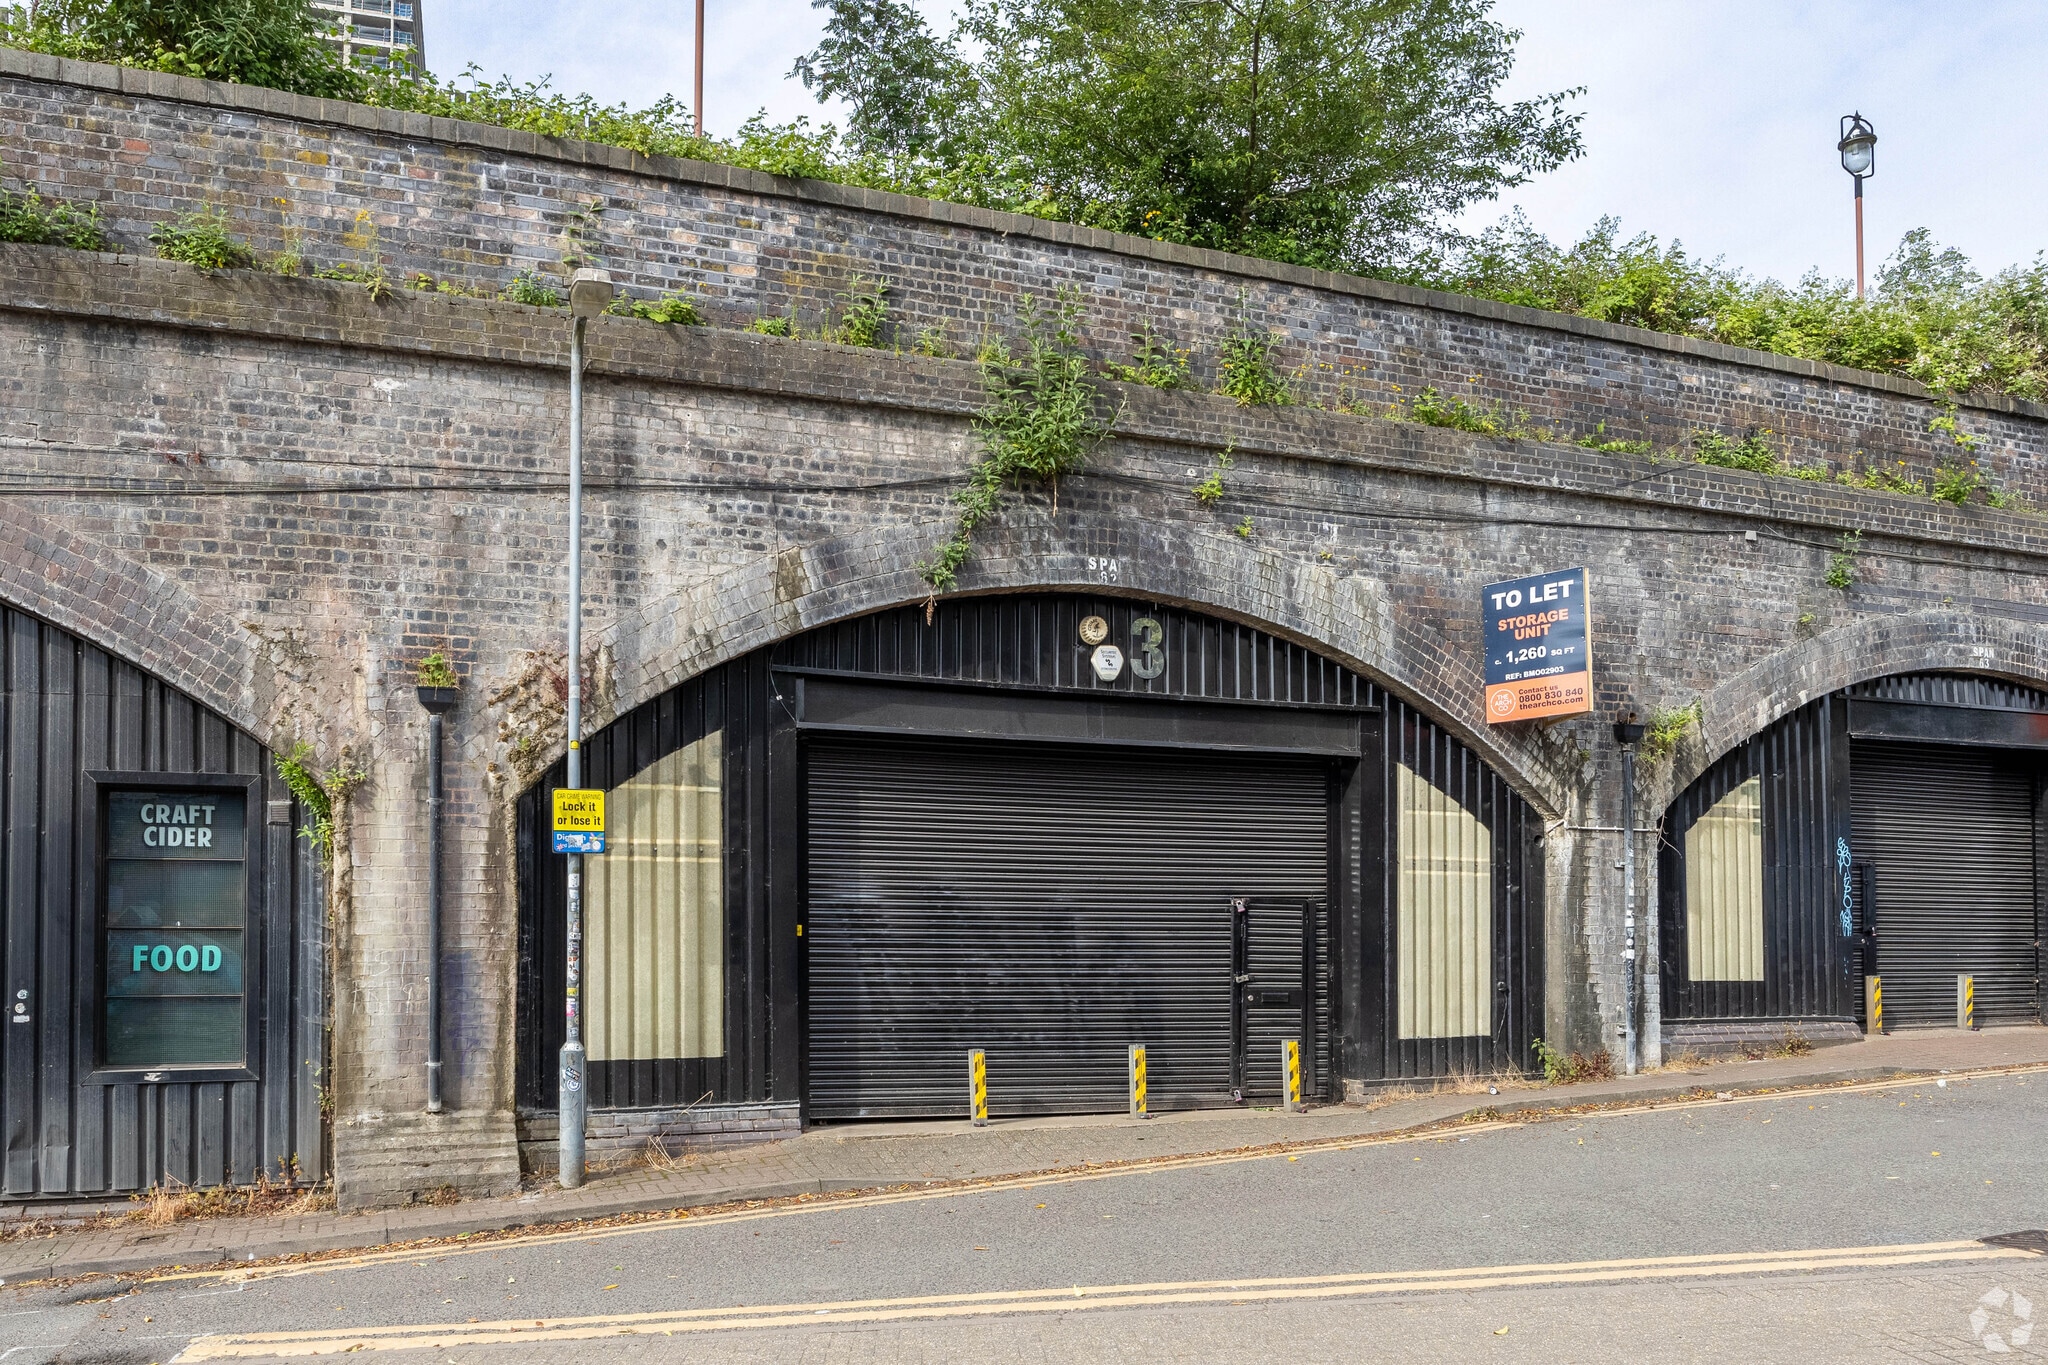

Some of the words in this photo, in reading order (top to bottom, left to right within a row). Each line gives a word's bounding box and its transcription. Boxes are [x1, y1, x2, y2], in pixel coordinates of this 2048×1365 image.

[1491, 590, 1522, 610] TO
[1530, 580, 1574, 604] LET
[1498, 608, 1569, 631] STORAGE
[1514, 624, 1551, 640] UNIT
[1130, 618, 1165, 680] 3
[1506, 646, 1546, 664] 1,260
[1973, 647, 1995, 659] SPAN
[1505, 673, 1522, 681] REF:
[1518, 686, 1547, 695] Contact
[1519, 694, 1541, 703] 0800
[1544, 690, 1562, 699] 830
[1565, 687, 1583, 697] 840
[1494, 699, 1512, 707] ARCH
[1519, 696, 1583, 710] thearchco.com
[141, 804, 215, 824] CRAFT
[562, 801, 585, 811] Lock
[589, 802, 596, 811] it
[557, 817, 567, 825] or
[570, 815, 590, 825] lose
[594, 816, 601, 825] it
[144, 826, 212, 847] CIDER
[133, 945, 222, 972] FOOD
